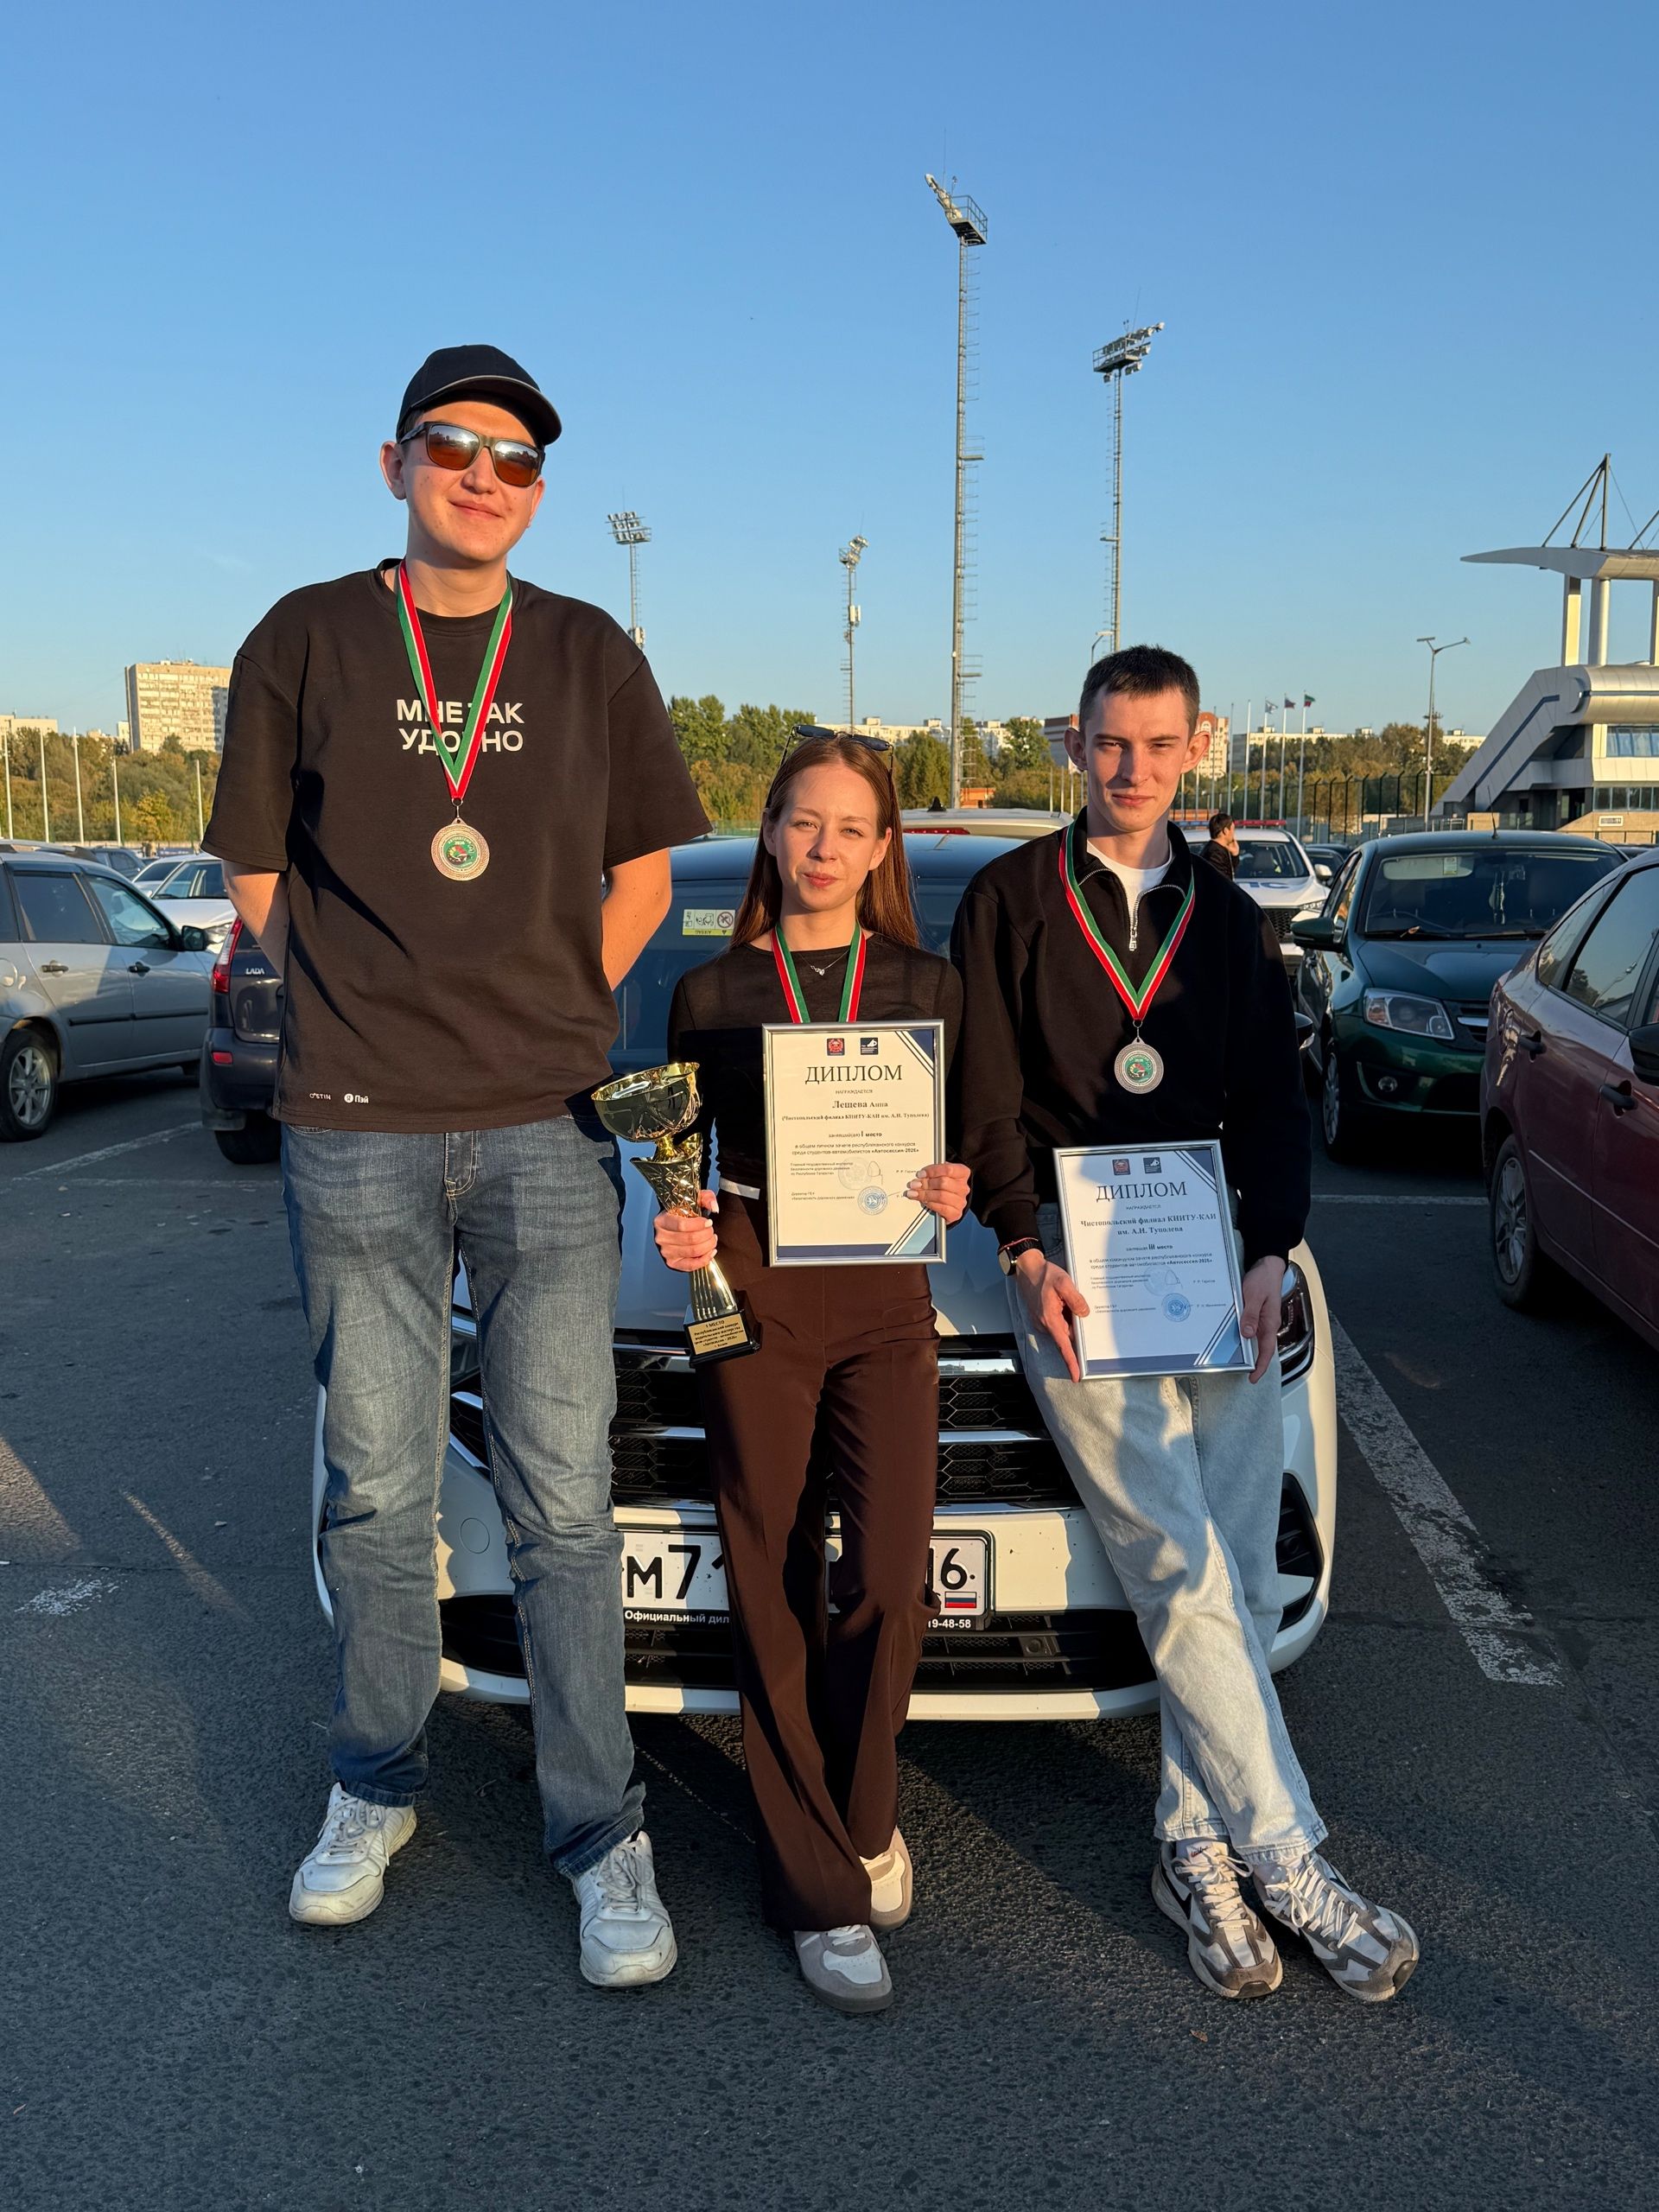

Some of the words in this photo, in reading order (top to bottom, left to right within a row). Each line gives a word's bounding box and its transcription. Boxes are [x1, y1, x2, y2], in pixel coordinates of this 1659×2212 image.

[467, 702, 524, 724] АК
[398, 728, 524, 756] УДОНО
[804, 1065, 903, 1085] ДИПЛОМ
[354, 1095, 369, 1103] Пэй
[832, 1100, 868, 1109] Лещева
[1096, 1181, 1187, 1203] ДИПЛОМ
[1080, 1218, 1137, 1228] Чистопольский
[1138, 1217, 1166, 1225] филиал
[1167, 1213, 1217, 1223] КНИТУ-КАИ
[1148, 1226, 1184, 1236] Туполева
[626, 1544, 724, 1599] М7
[624, 1610, 706, 1623] Официальный
